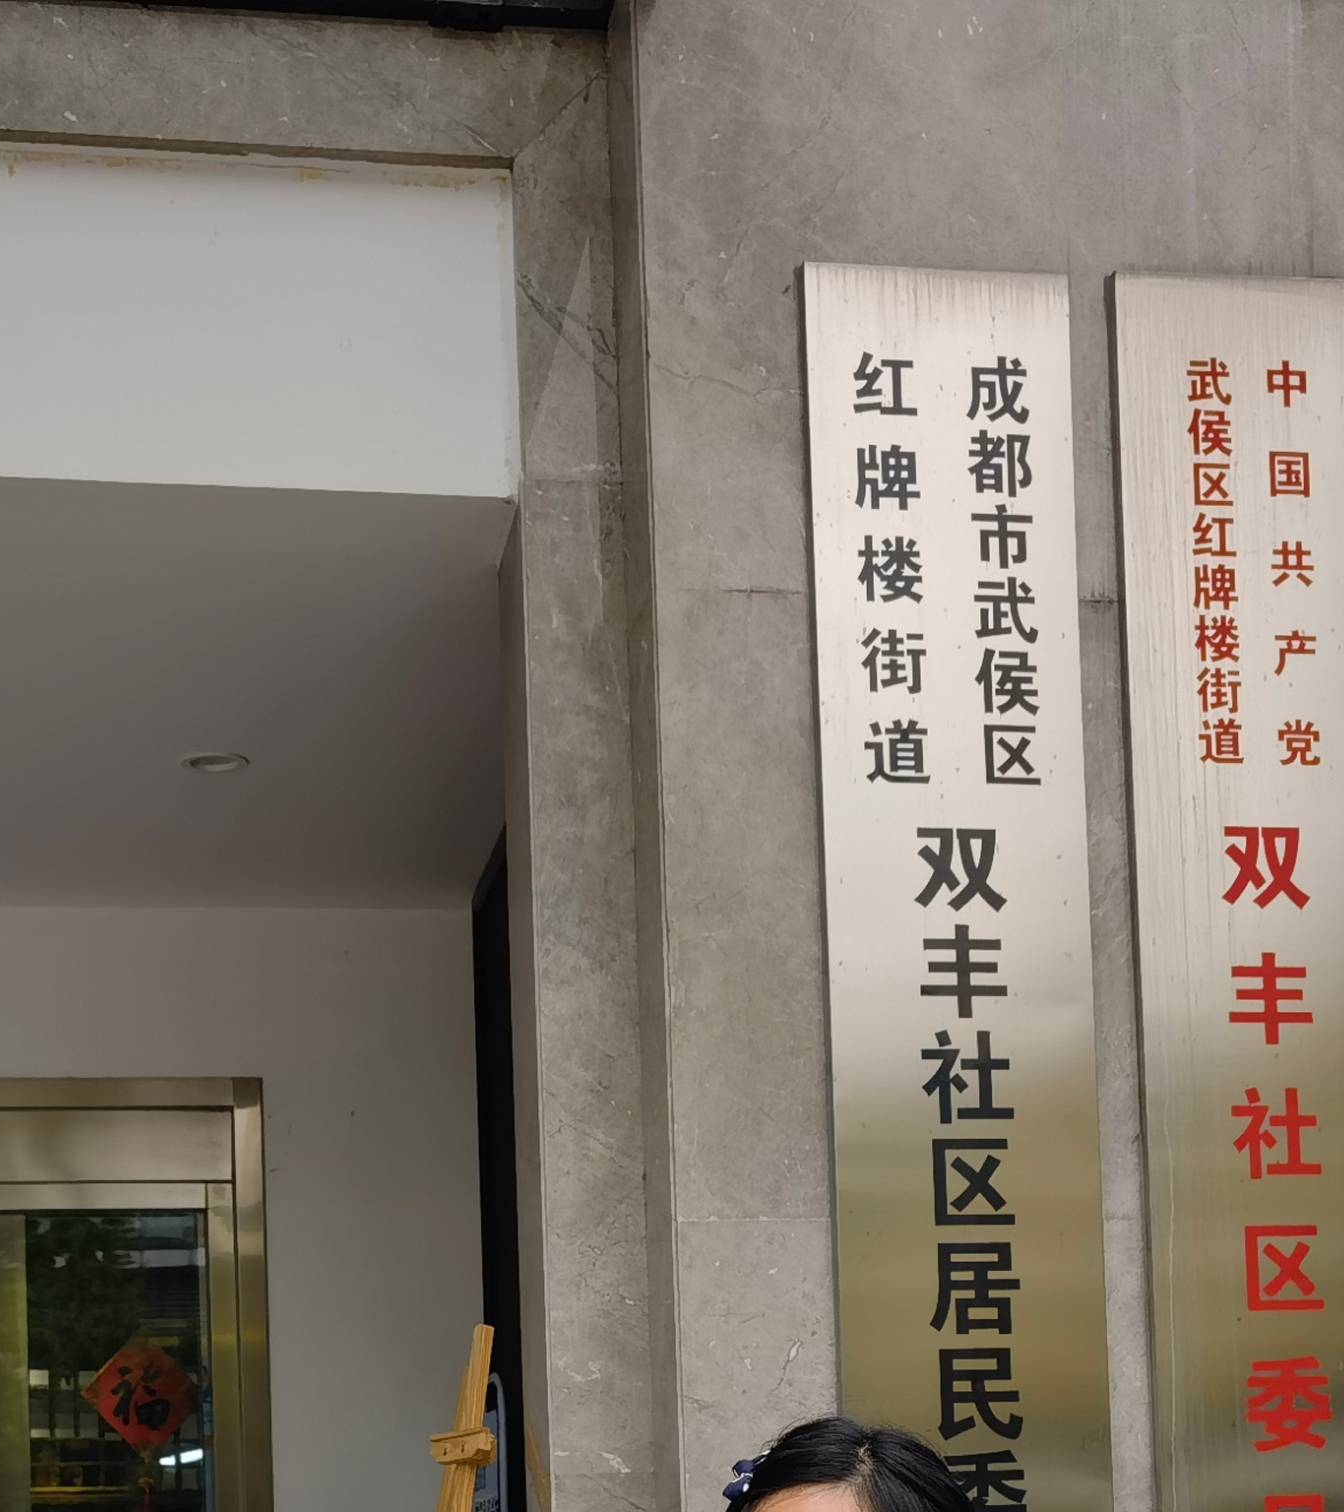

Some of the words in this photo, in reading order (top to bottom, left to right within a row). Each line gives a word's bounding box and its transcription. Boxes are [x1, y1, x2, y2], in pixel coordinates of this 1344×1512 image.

[853, 351, 931, 785] 红牌楼街道
[966, 355, 1043, 786] 成都市武侯区
[1186, 357, 1245, 766] 武侯区红牌楼街道
[1265, 360, 1322, 767] 中国共产党
